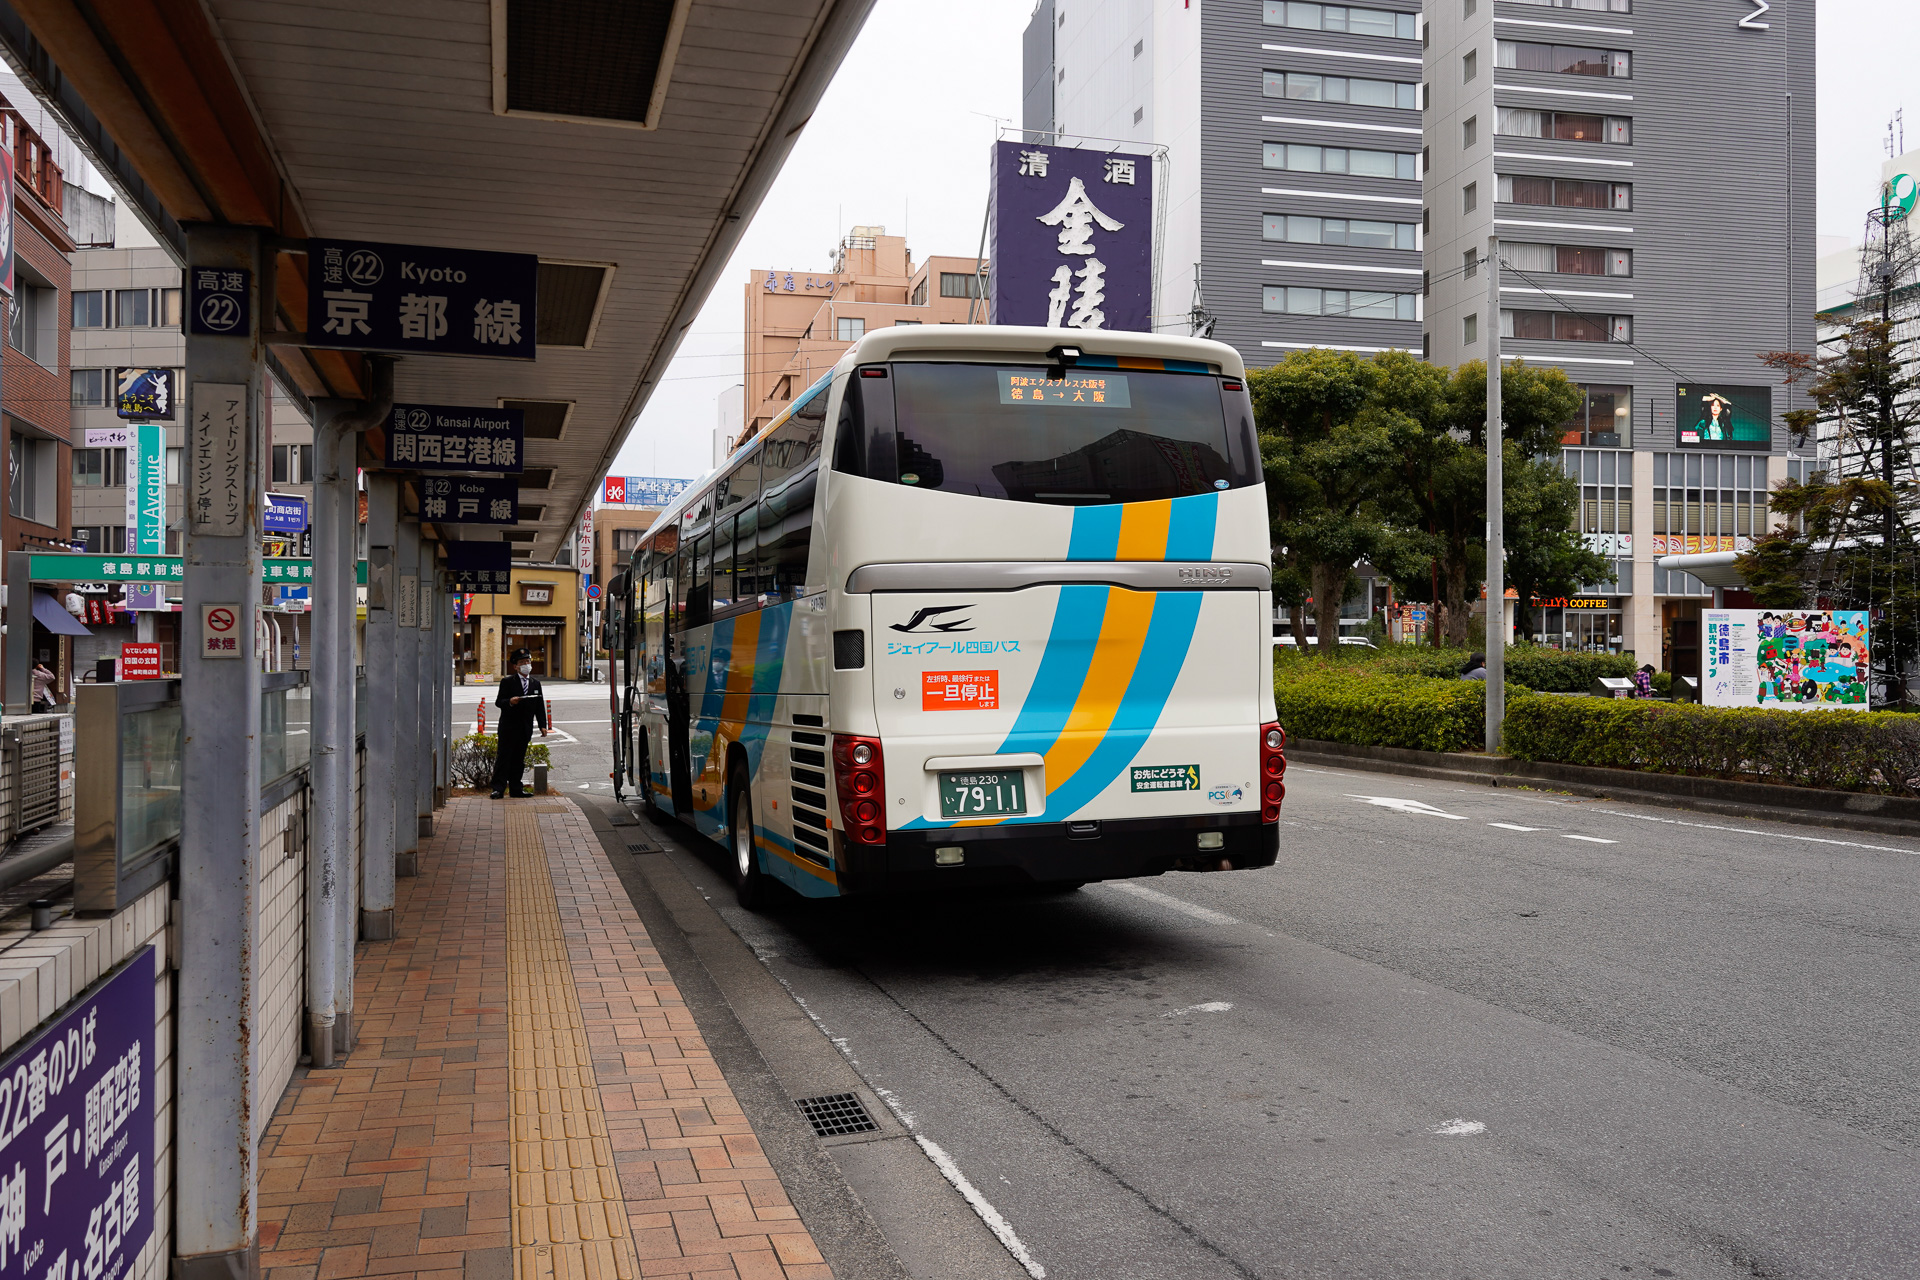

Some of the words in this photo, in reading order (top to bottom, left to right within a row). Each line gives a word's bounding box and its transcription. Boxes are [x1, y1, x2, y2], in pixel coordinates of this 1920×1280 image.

[323, 247, 343, 284] 高速
[349, 252, 380, 282] 22
[401, 262, 467, 284] Kyoto
[197, 270, 244, 292] 高速
[204, 296, 237, 327] 22
[322, 289, 522, 345] 京都線
[1010, 376, 1106, 389] 阿波エクスプレス大阪号
[122, 393, 154, 404] ようこそ
[1011, 387, 1044, 400] 徳島
[1073, 389, 1105, 402] 大阪
[122, 403, 154, 413] 徳島へ
[393, 408, 406, 431] 高速
[410, 411, 429, 429] 22
[436, 415, 471, 428] Kansai
[473, 417, 510, 432] Airport
[392, 433, 517, 466] 関西空港線
[196, 411, 213, 525] メインエンジン停止
[224, 400, 239, 526] アイドリングストップ
[143, 454, 160, 519] Avenue
[436, 480, 450, 494] 22
[459, 483, 485, 494] Kobe
[264, 506, 302, 516] 町商店街
[424, 497, 513, 520] 神戸線
[143, 521, 160, 545] 1st
[580, 503, 592, 568] 観光ホテル
[459, 570, 508, 583] 大阪線
[1178, 567, 1234, 577] HINO
[1569, 599, 1608, 608] COFFEE
[207, 637, 237, 650] 禁煙
[887, 640, 1021, 655] ジェイアール四国バス
[1708, 623, 1718, 678] 観光マップ
[1718, 623, 1730, 665] 徳島市
[124, 657, 158, 665] 四国の玄関
[926, 683, 995, 701] 一旦停止
[960, 776, 977, 785] 徳島
[978, 775, 998, 785] 230
[1133, 768, 1186, 780] お先にどうぞ
[945, 796, 955, 804] い
[956, 784, 1018, 812] 79-11
[1208, 790, 1226, 800] PCS
[99, 1146, 114, 1179] Kansai
[114, 1130, 129, 1161] Airport
[23, 1238, 45, 1276] Kobe
